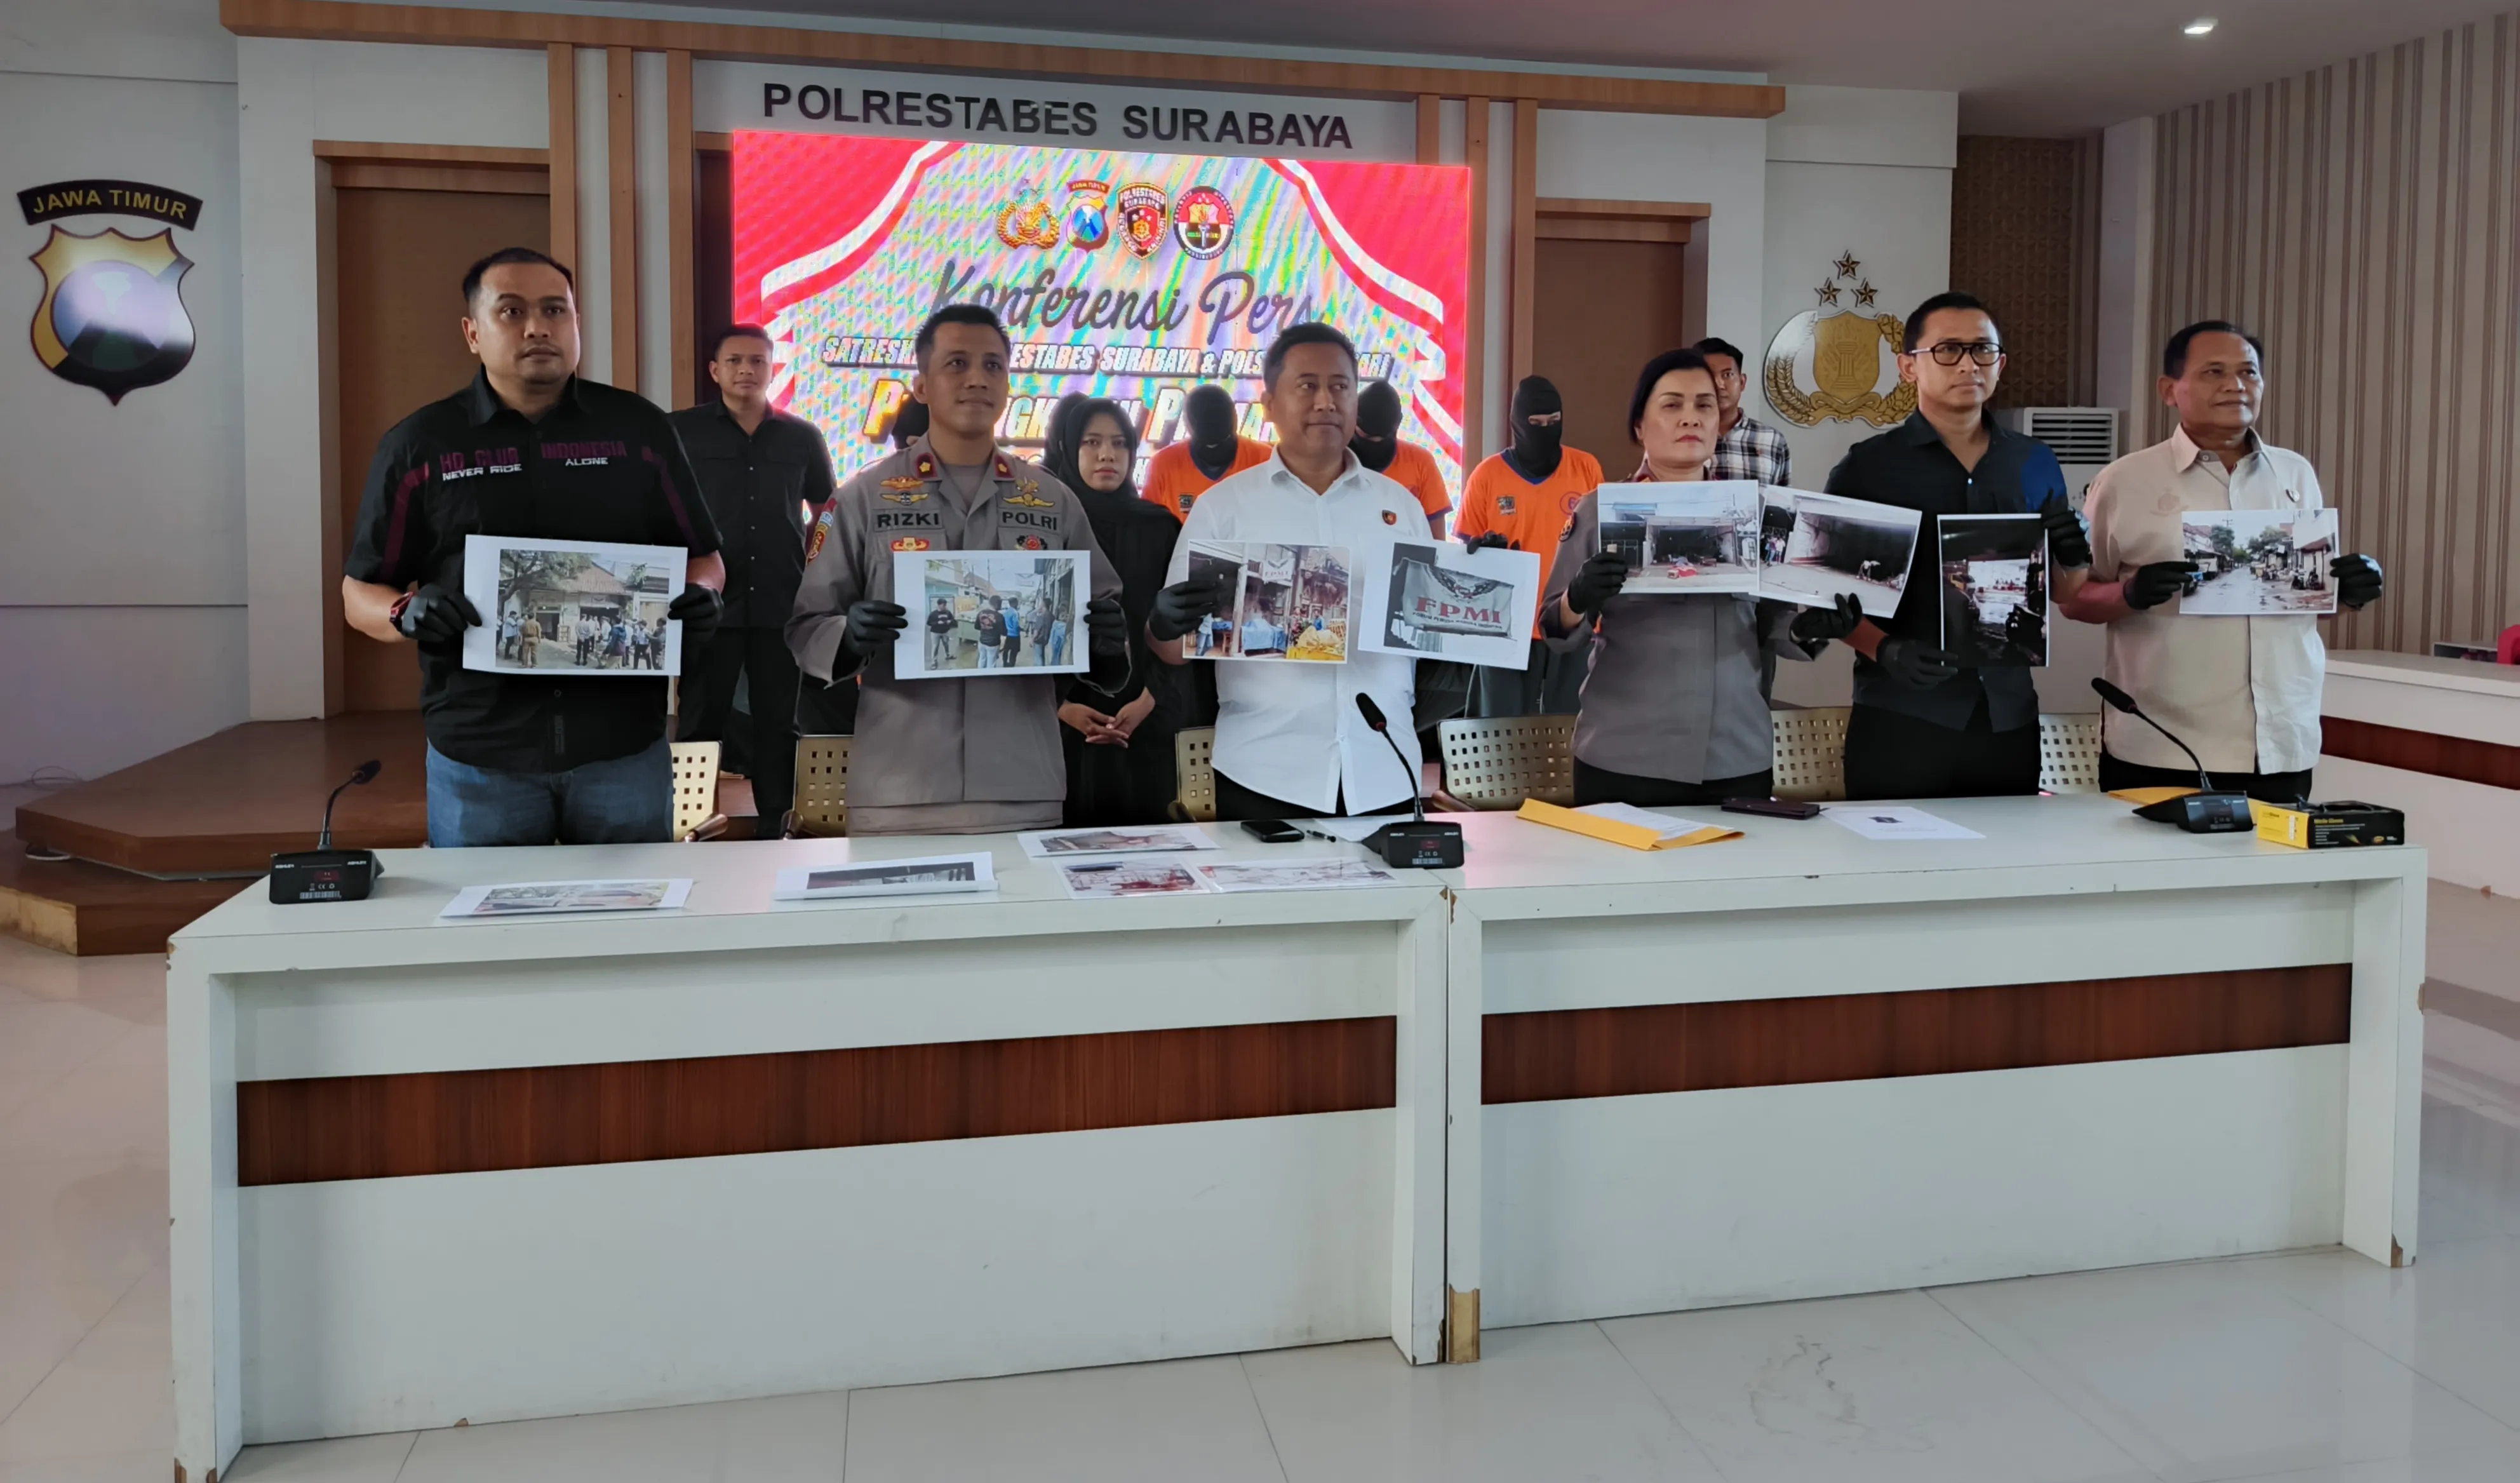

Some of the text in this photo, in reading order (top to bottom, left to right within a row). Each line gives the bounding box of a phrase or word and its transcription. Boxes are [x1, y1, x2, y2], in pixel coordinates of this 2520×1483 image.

[764, 83, 1353, 149] POLRESTABES SURABAYA
[34, 190, 187, 219] JAWA TIMUR
[927, 260, 1325, 345] Konferensi Pers
[1100, 347, 1201, 374] SURABAYA
[1201, 351, 1217, 373] &
[439, 452, 465, 471] HD
[540, 441, 627, 459] INDONESIA
[443, 457, 608, 481] NEVER RIDE ALONE
[877, 512, 940, 528] RIZKI
[1002, 511, 1057, 530] POLRI
[1414, 596, 1502, 624] FPMI
